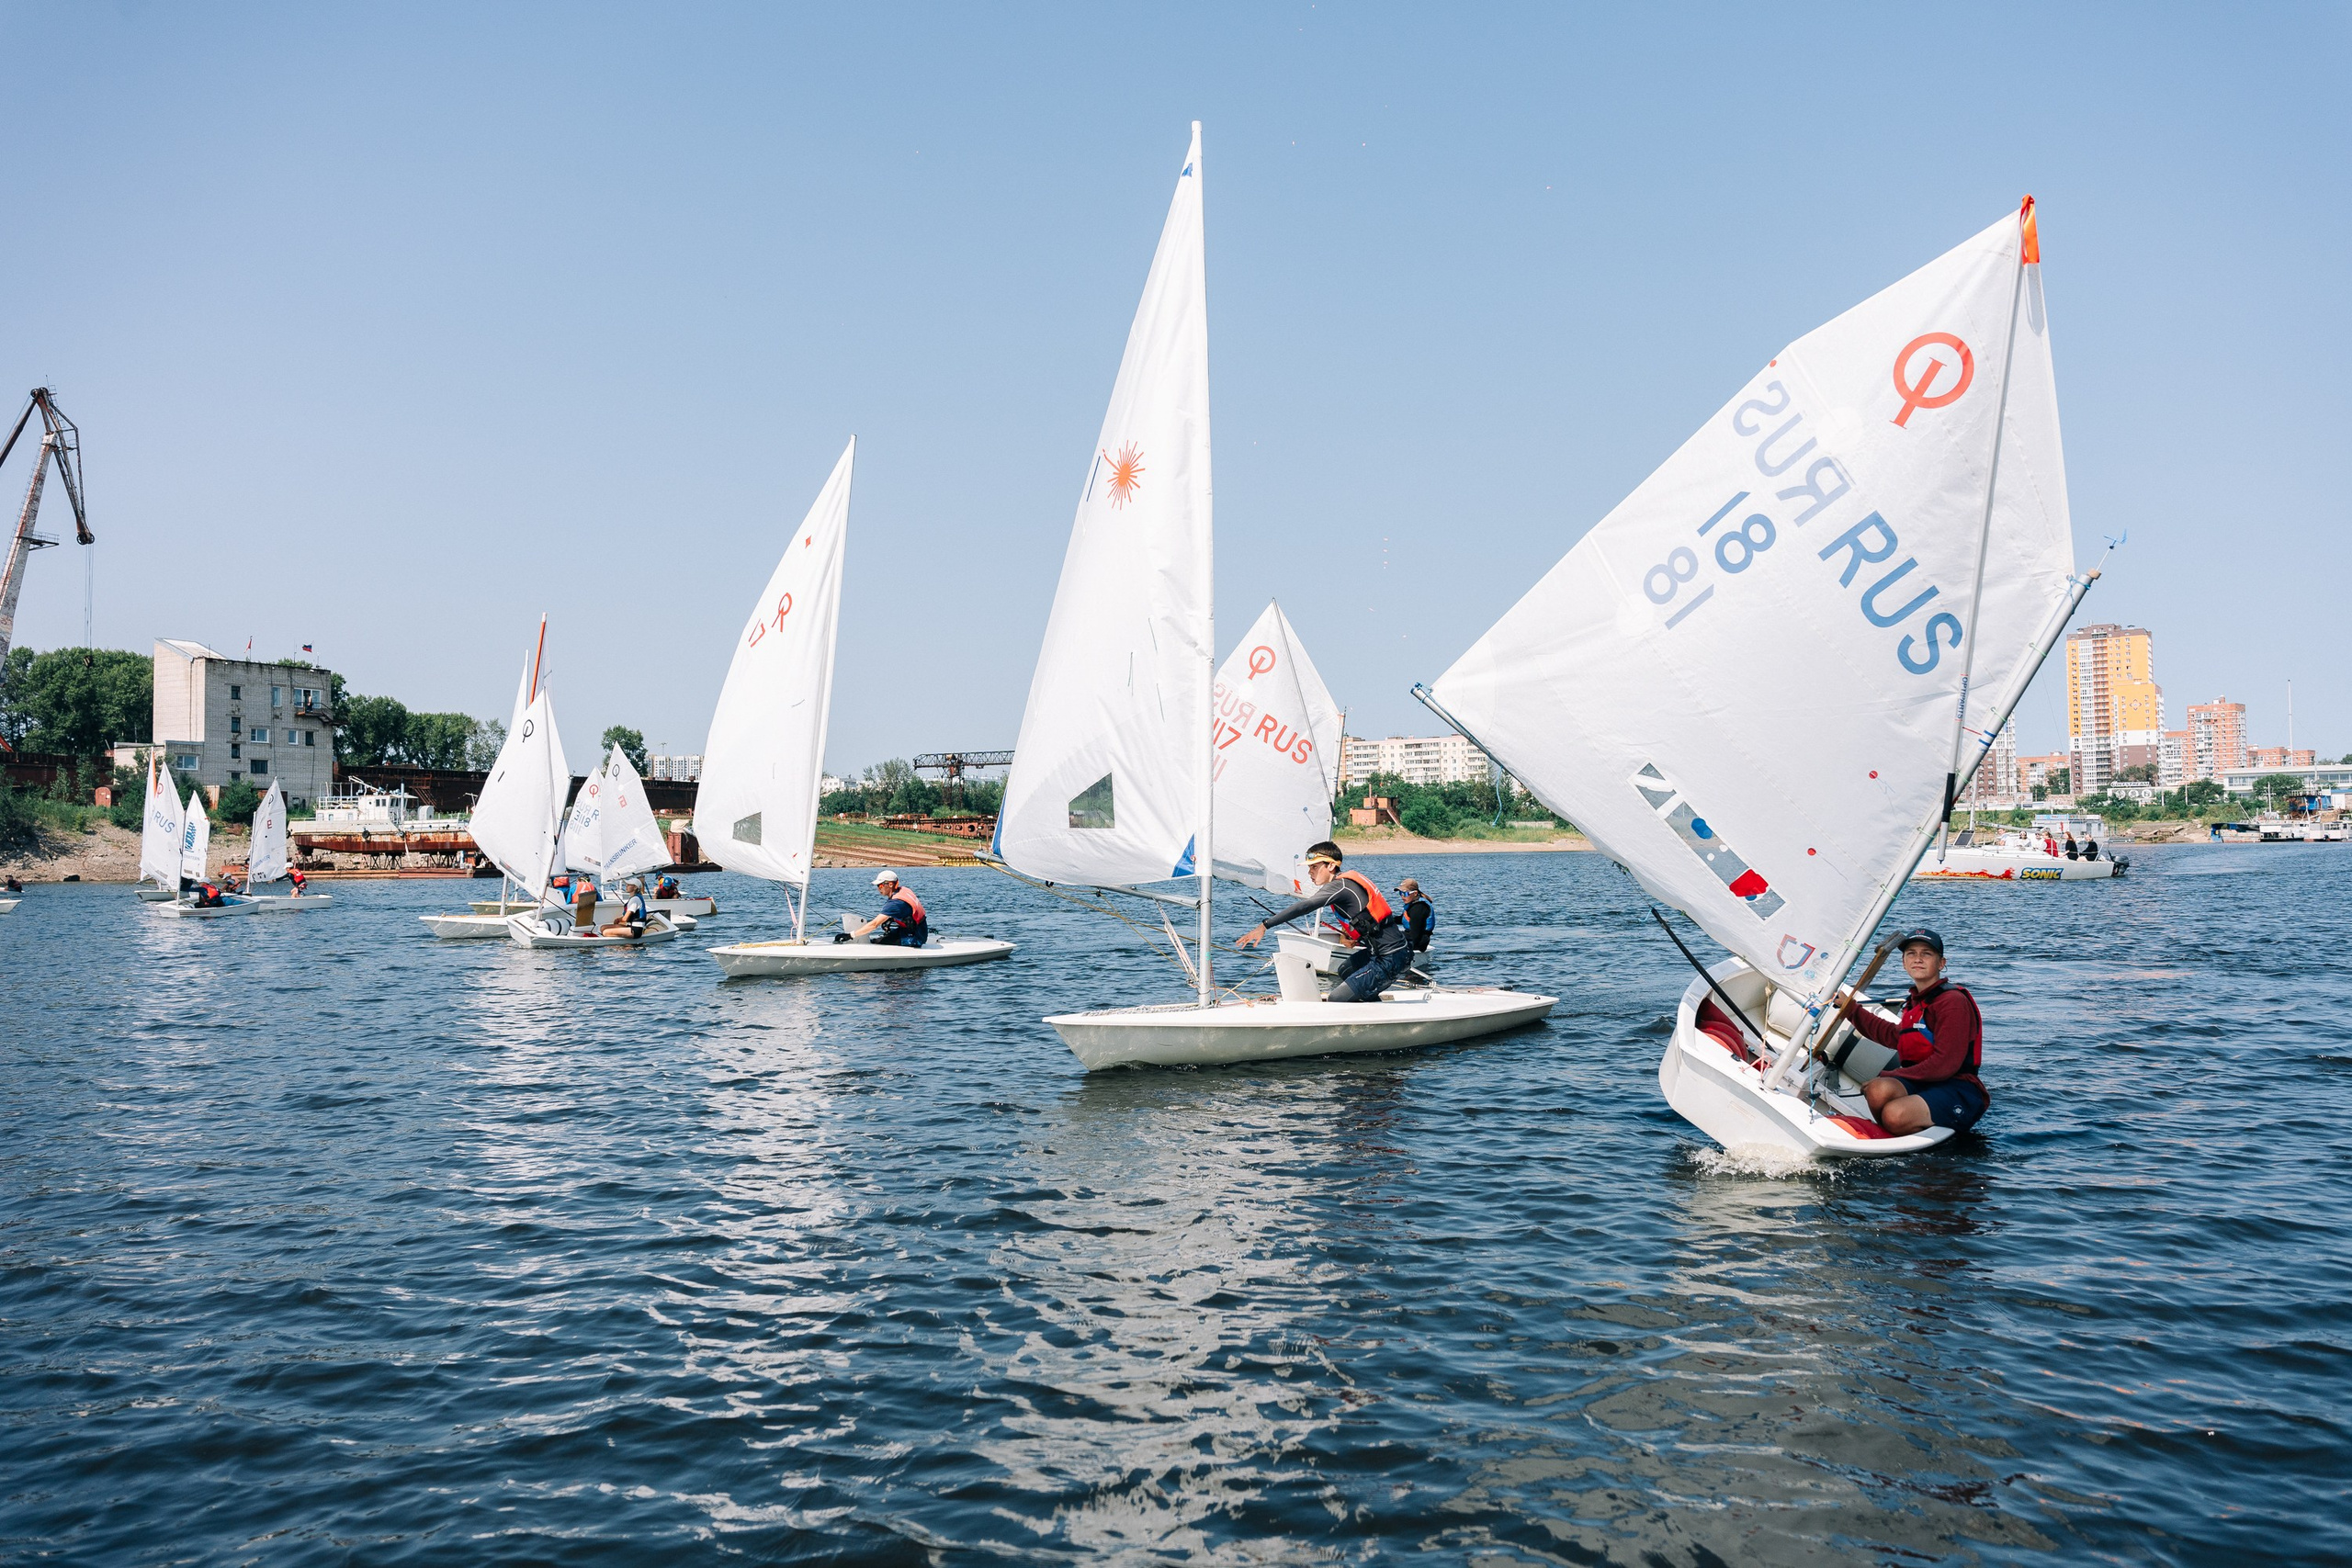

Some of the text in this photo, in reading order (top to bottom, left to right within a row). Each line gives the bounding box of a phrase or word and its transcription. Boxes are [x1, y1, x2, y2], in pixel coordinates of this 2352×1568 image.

[1697, 491, 1777, 574] 18
[1818, 510, 1963, 675] RUS
[1957, 676, 1968, 719] OPTIPARTS
[1254, 714, 1313, 764] RUS
[154, 811, 175, 833] RUS
[2020, 867, 2064, 880] SONIC
